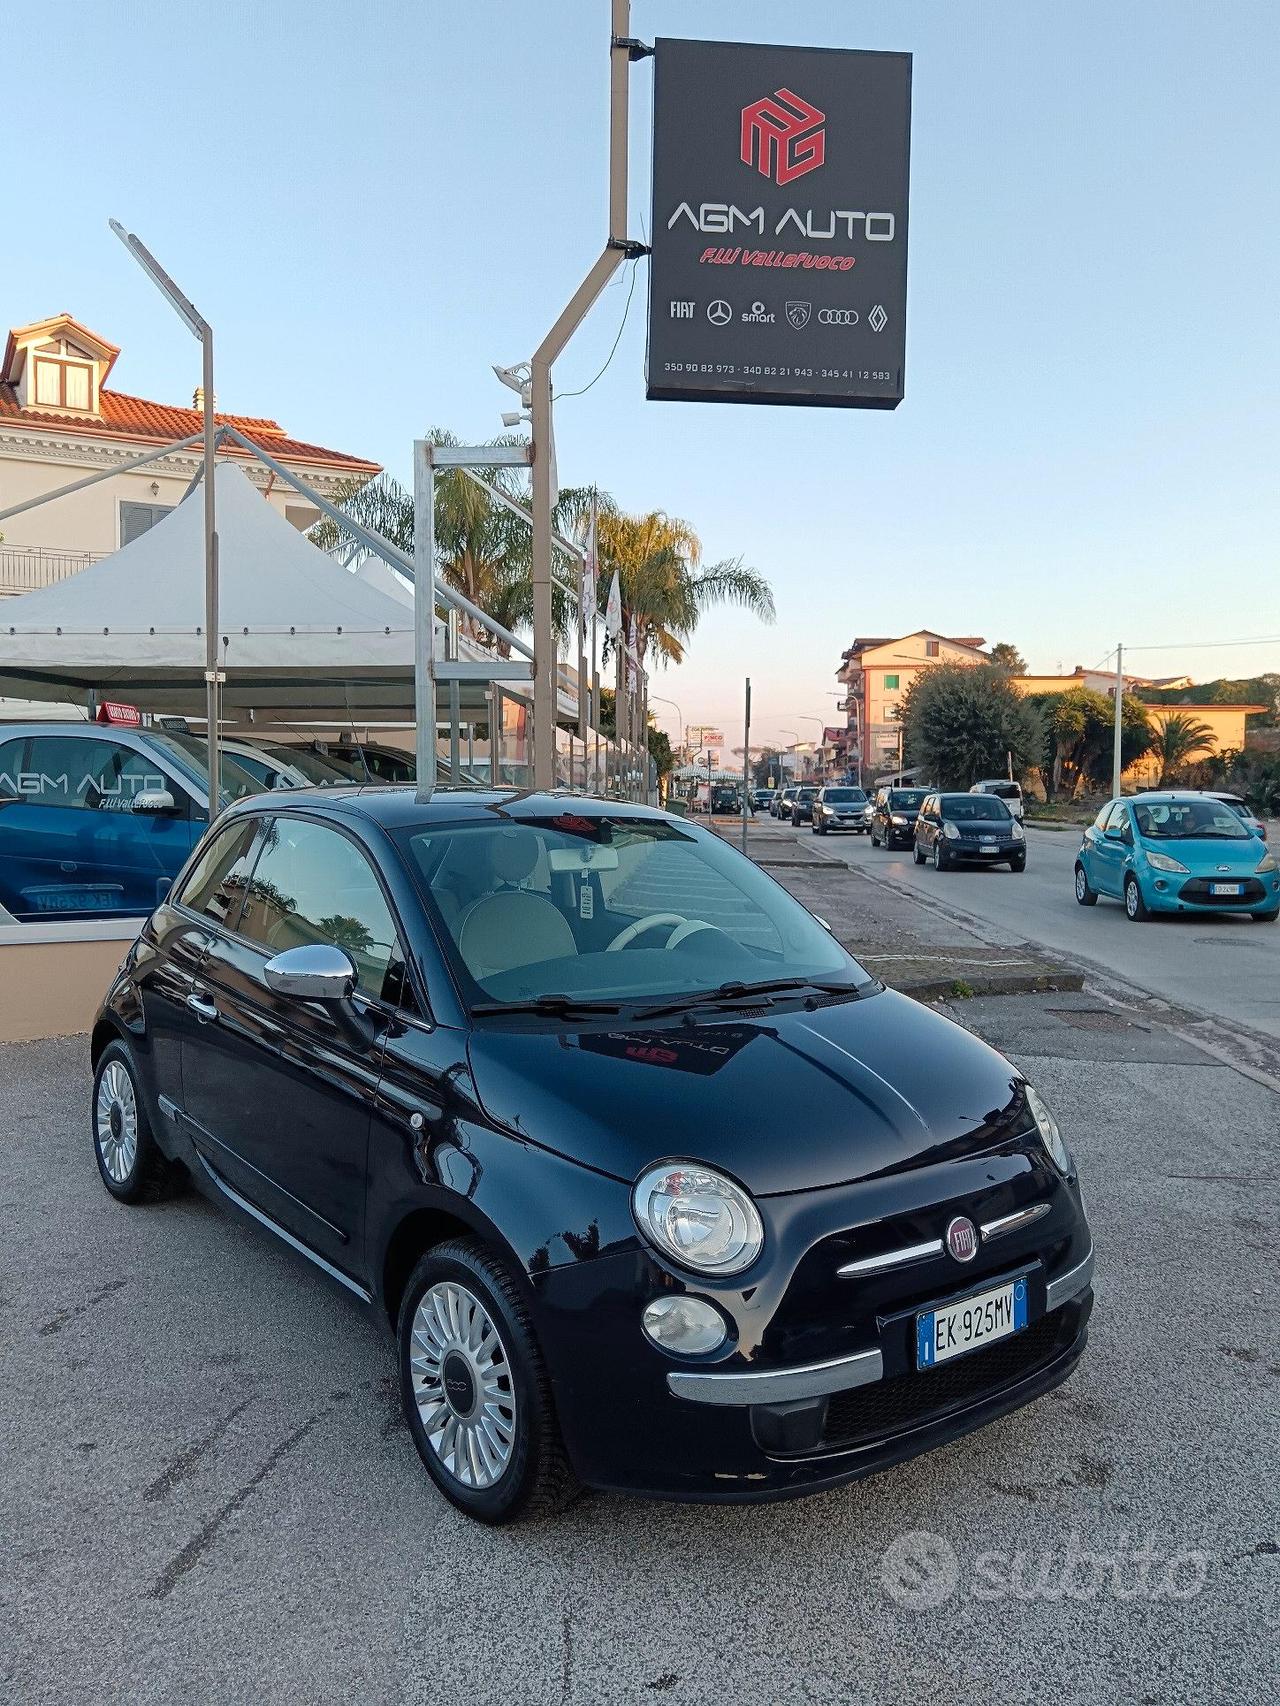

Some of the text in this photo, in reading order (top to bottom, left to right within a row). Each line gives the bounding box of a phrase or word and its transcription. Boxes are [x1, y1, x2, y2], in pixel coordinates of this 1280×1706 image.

[668, 202, 895, 241] AGM AUTO
[670, 301, 695, 319] FIAT
[742, 312, 775, 323] smart
[664, 362, 890, 380] 350 90 82 973 340 82 21 943 345 41 12 583
[0, 772, 165, 796] AGM AUTO
[954, 1228, 973, 1253] FIAT
[936, 1316, 957, 1352] EK
[963, 1294, 1013, 1341] 925MV
